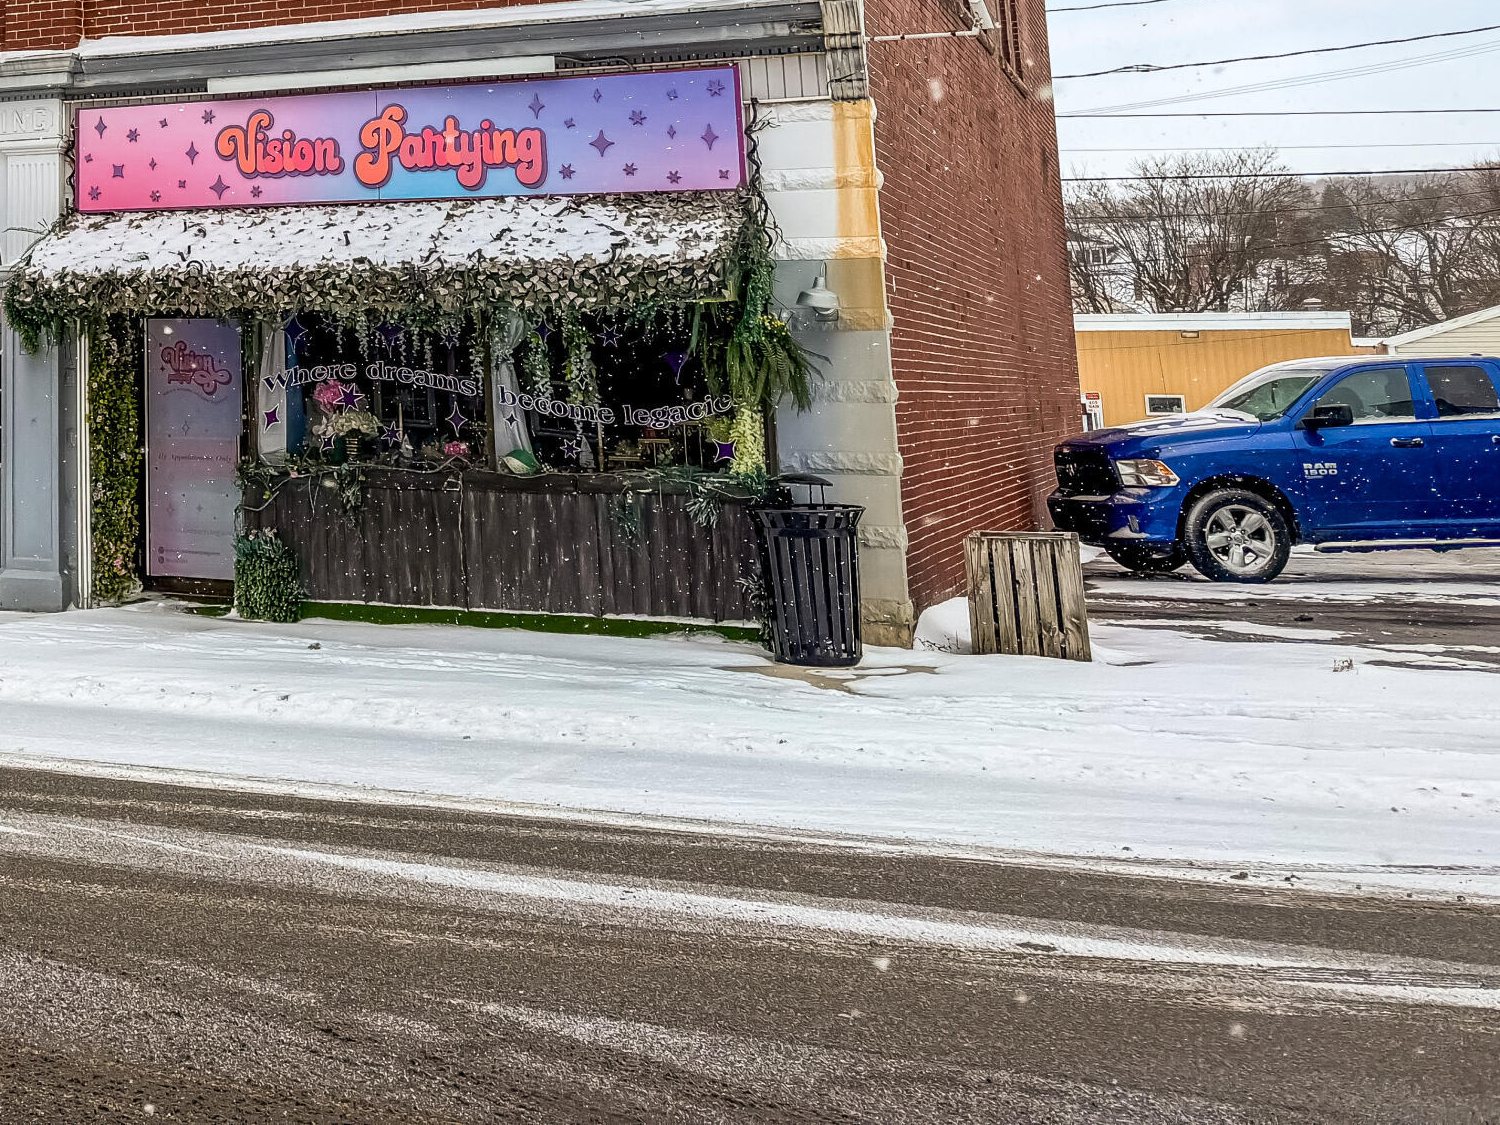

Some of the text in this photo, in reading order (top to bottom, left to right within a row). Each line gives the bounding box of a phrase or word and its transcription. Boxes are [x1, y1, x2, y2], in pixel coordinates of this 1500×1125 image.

[216, 104, 547, 189] Vision Partying
[262, 361, 477, 396] where dreams
[498, 385, 616, 424] become
